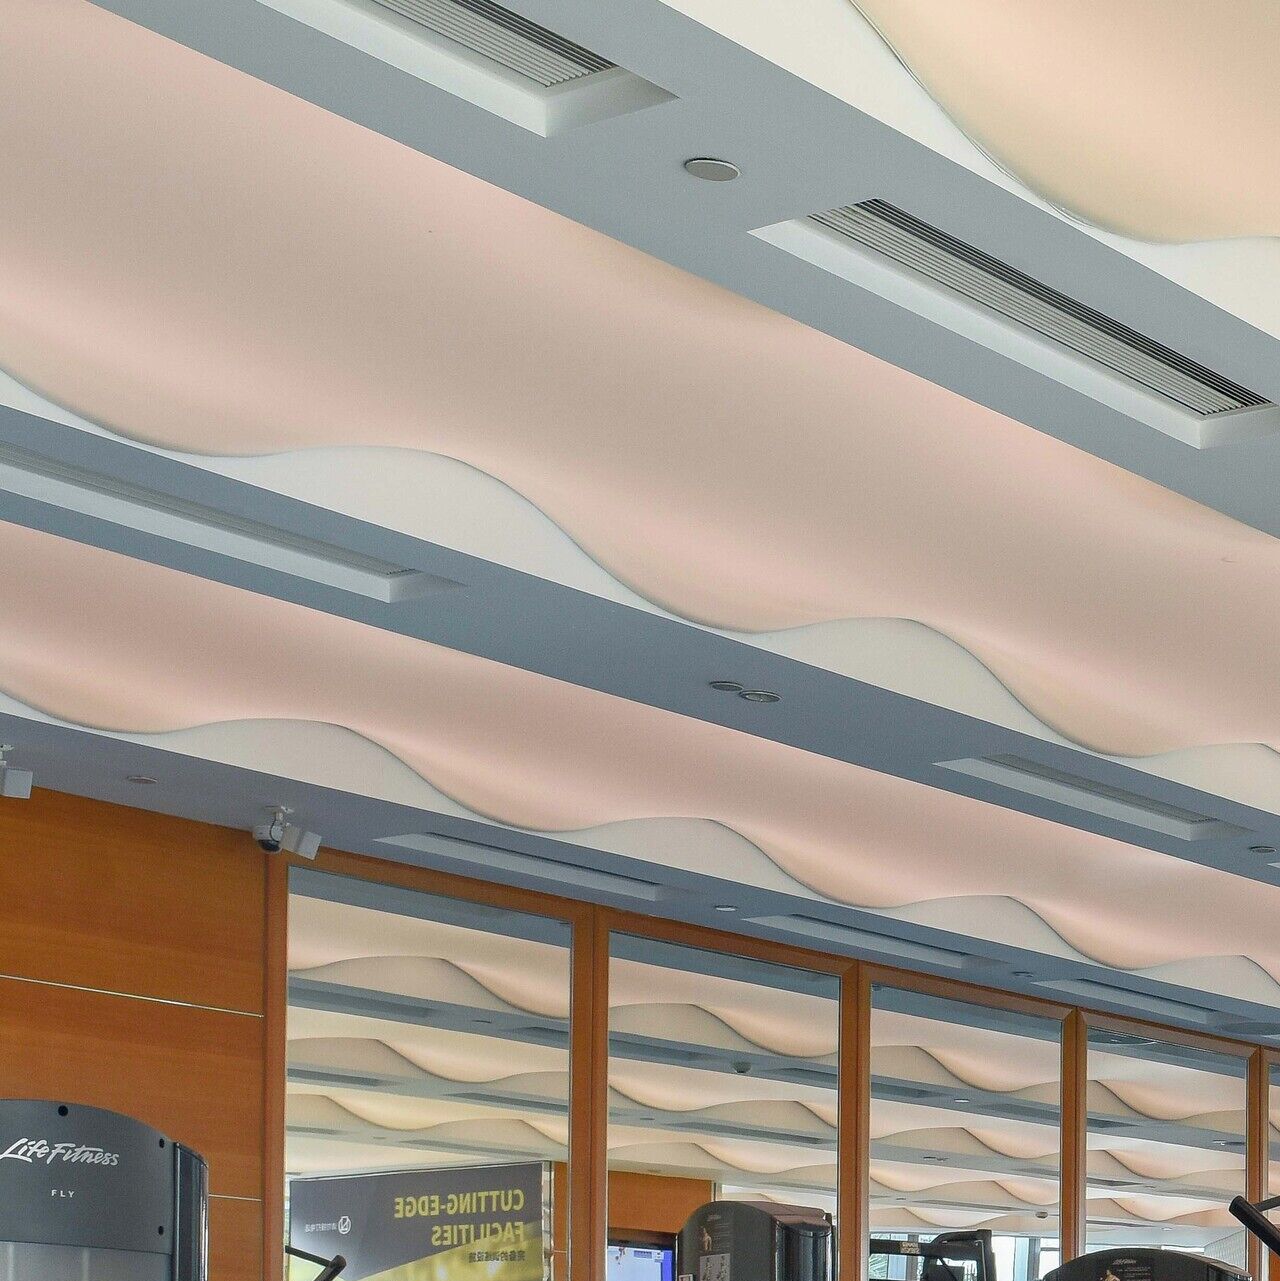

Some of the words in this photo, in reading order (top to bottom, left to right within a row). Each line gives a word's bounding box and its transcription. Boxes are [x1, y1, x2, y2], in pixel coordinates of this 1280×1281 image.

[0, 1138, 50, 1163] Life
[47, 1143, 120, 1166] Fitness
[51, 1189, 75, 1198] FLY
